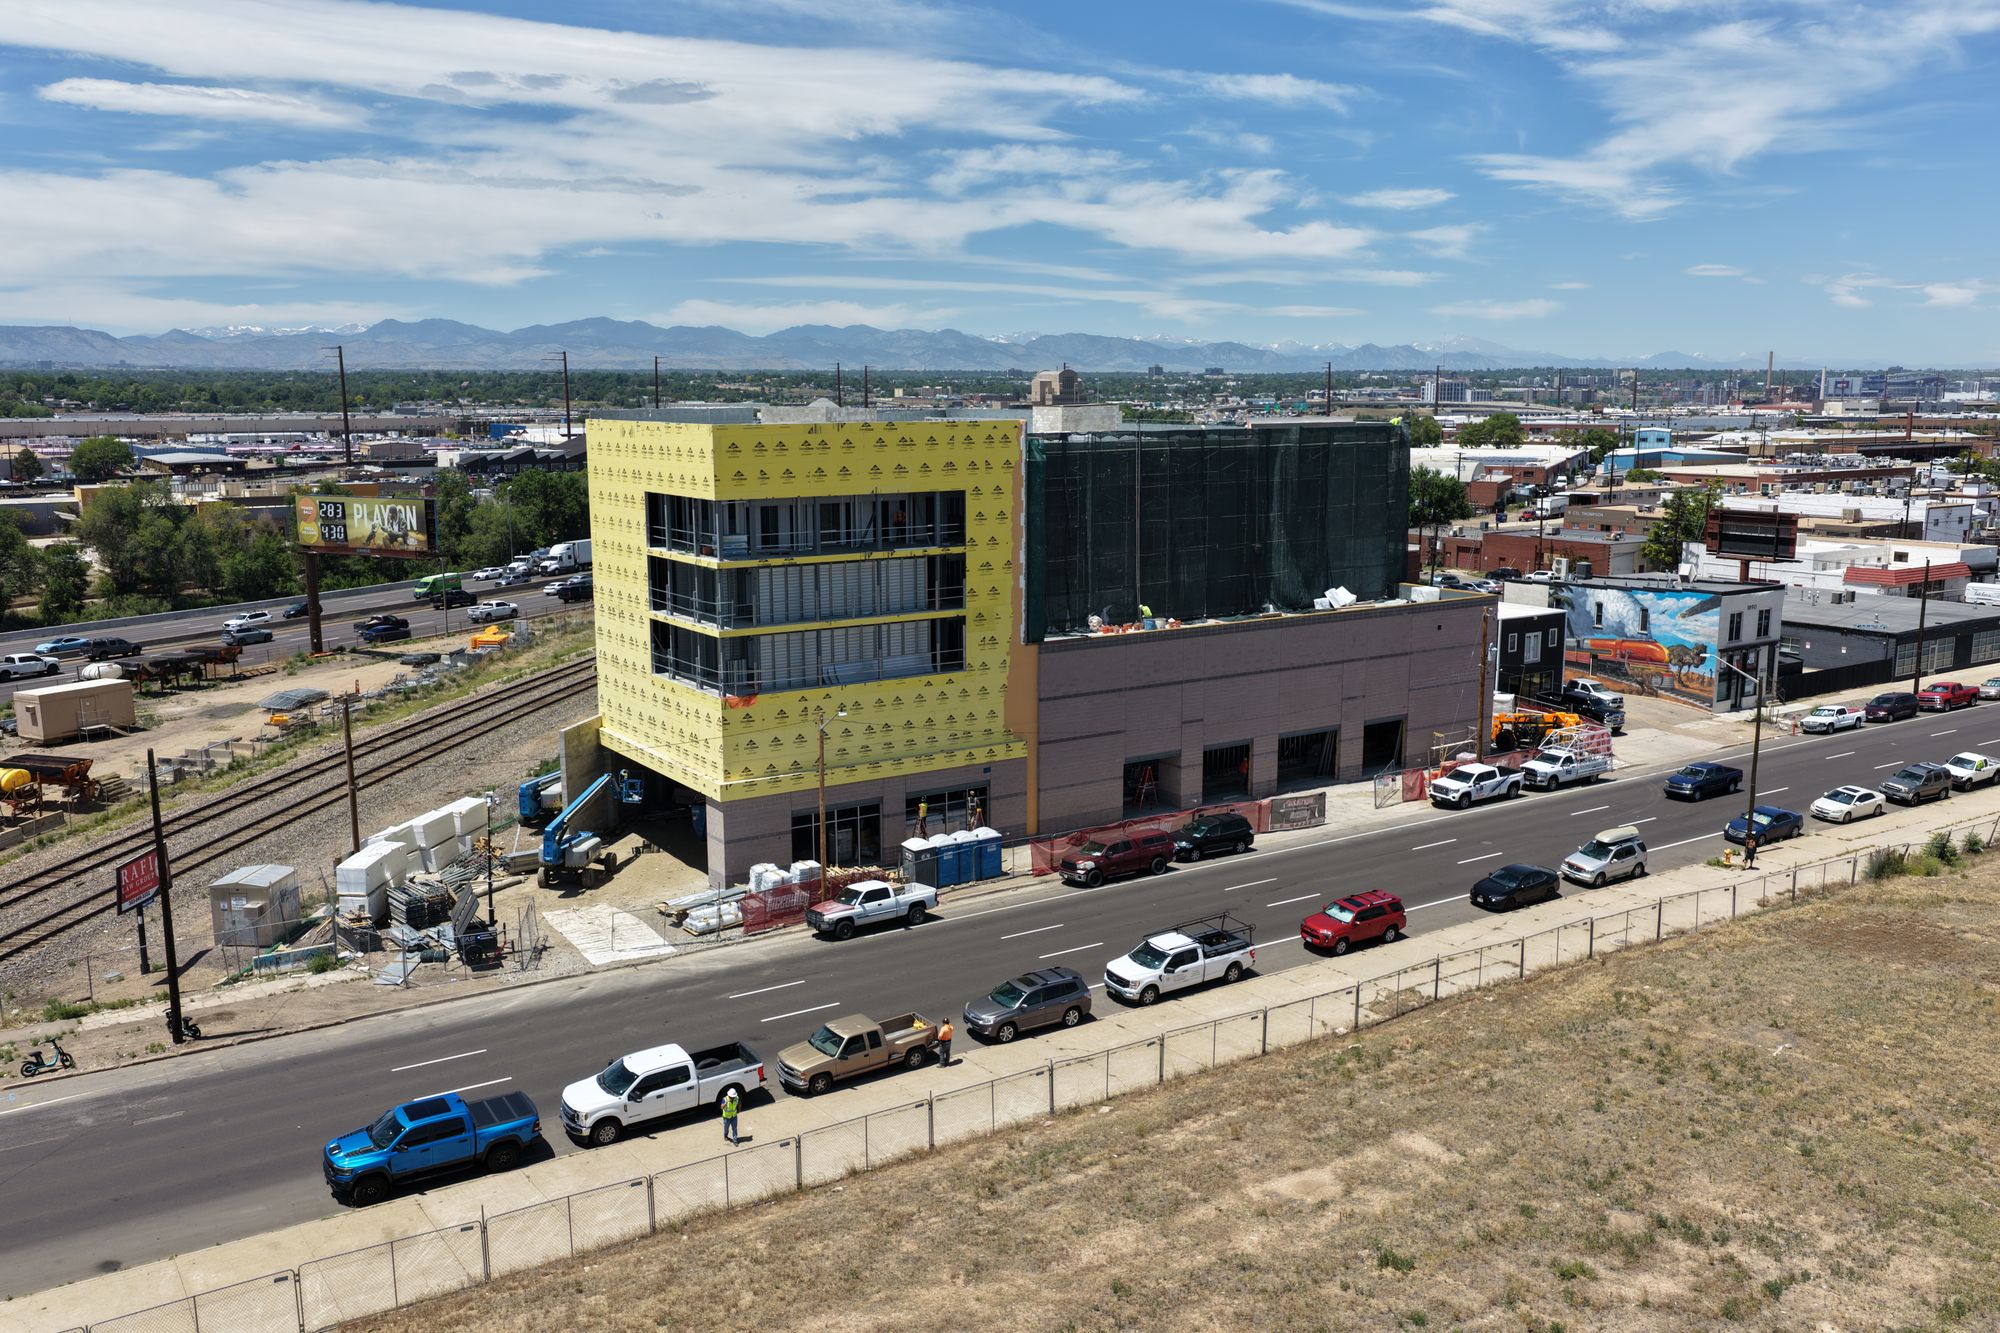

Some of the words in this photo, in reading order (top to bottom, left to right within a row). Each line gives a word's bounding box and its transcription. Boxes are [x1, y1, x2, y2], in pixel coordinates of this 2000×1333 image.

[320, 503, 342, 517] 283
[321, 525, 344, 539] 430
[121, 856, 154, 885] RAFI
